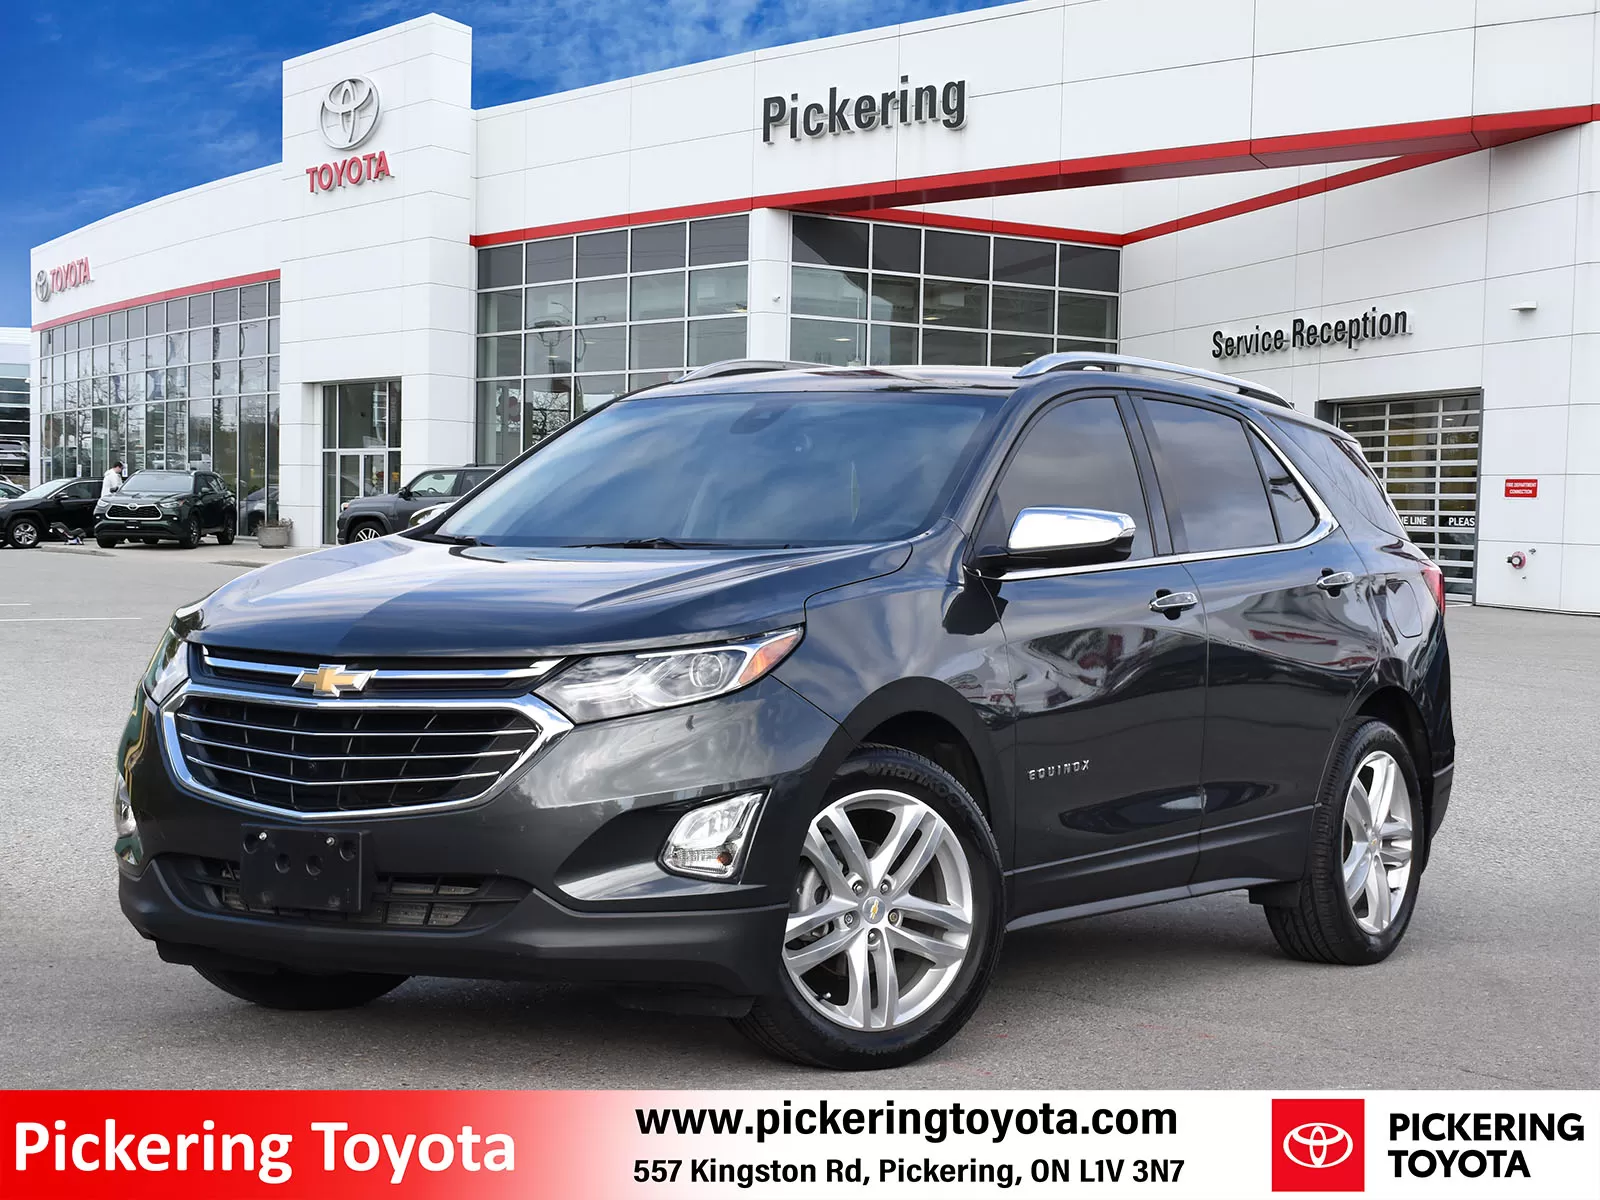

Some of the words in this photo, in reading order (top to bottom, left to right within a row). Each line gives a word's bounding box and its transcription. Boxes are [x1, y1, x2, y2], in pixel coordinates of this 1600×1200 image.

[763, 75, 966, 142] Pickering
[306, 150, 391, 193] TOYOTA
[49, 256, 91, 294] TOYOTA
[1212, 324, 1285, 359] Service
[1292, 306, 1408, 349] Reception
[1410, 516, 1427, 525] LINE
[1448, 517, 1476, 527] PLEAS
[1028, 759, 1090, 781] EQUINOX
